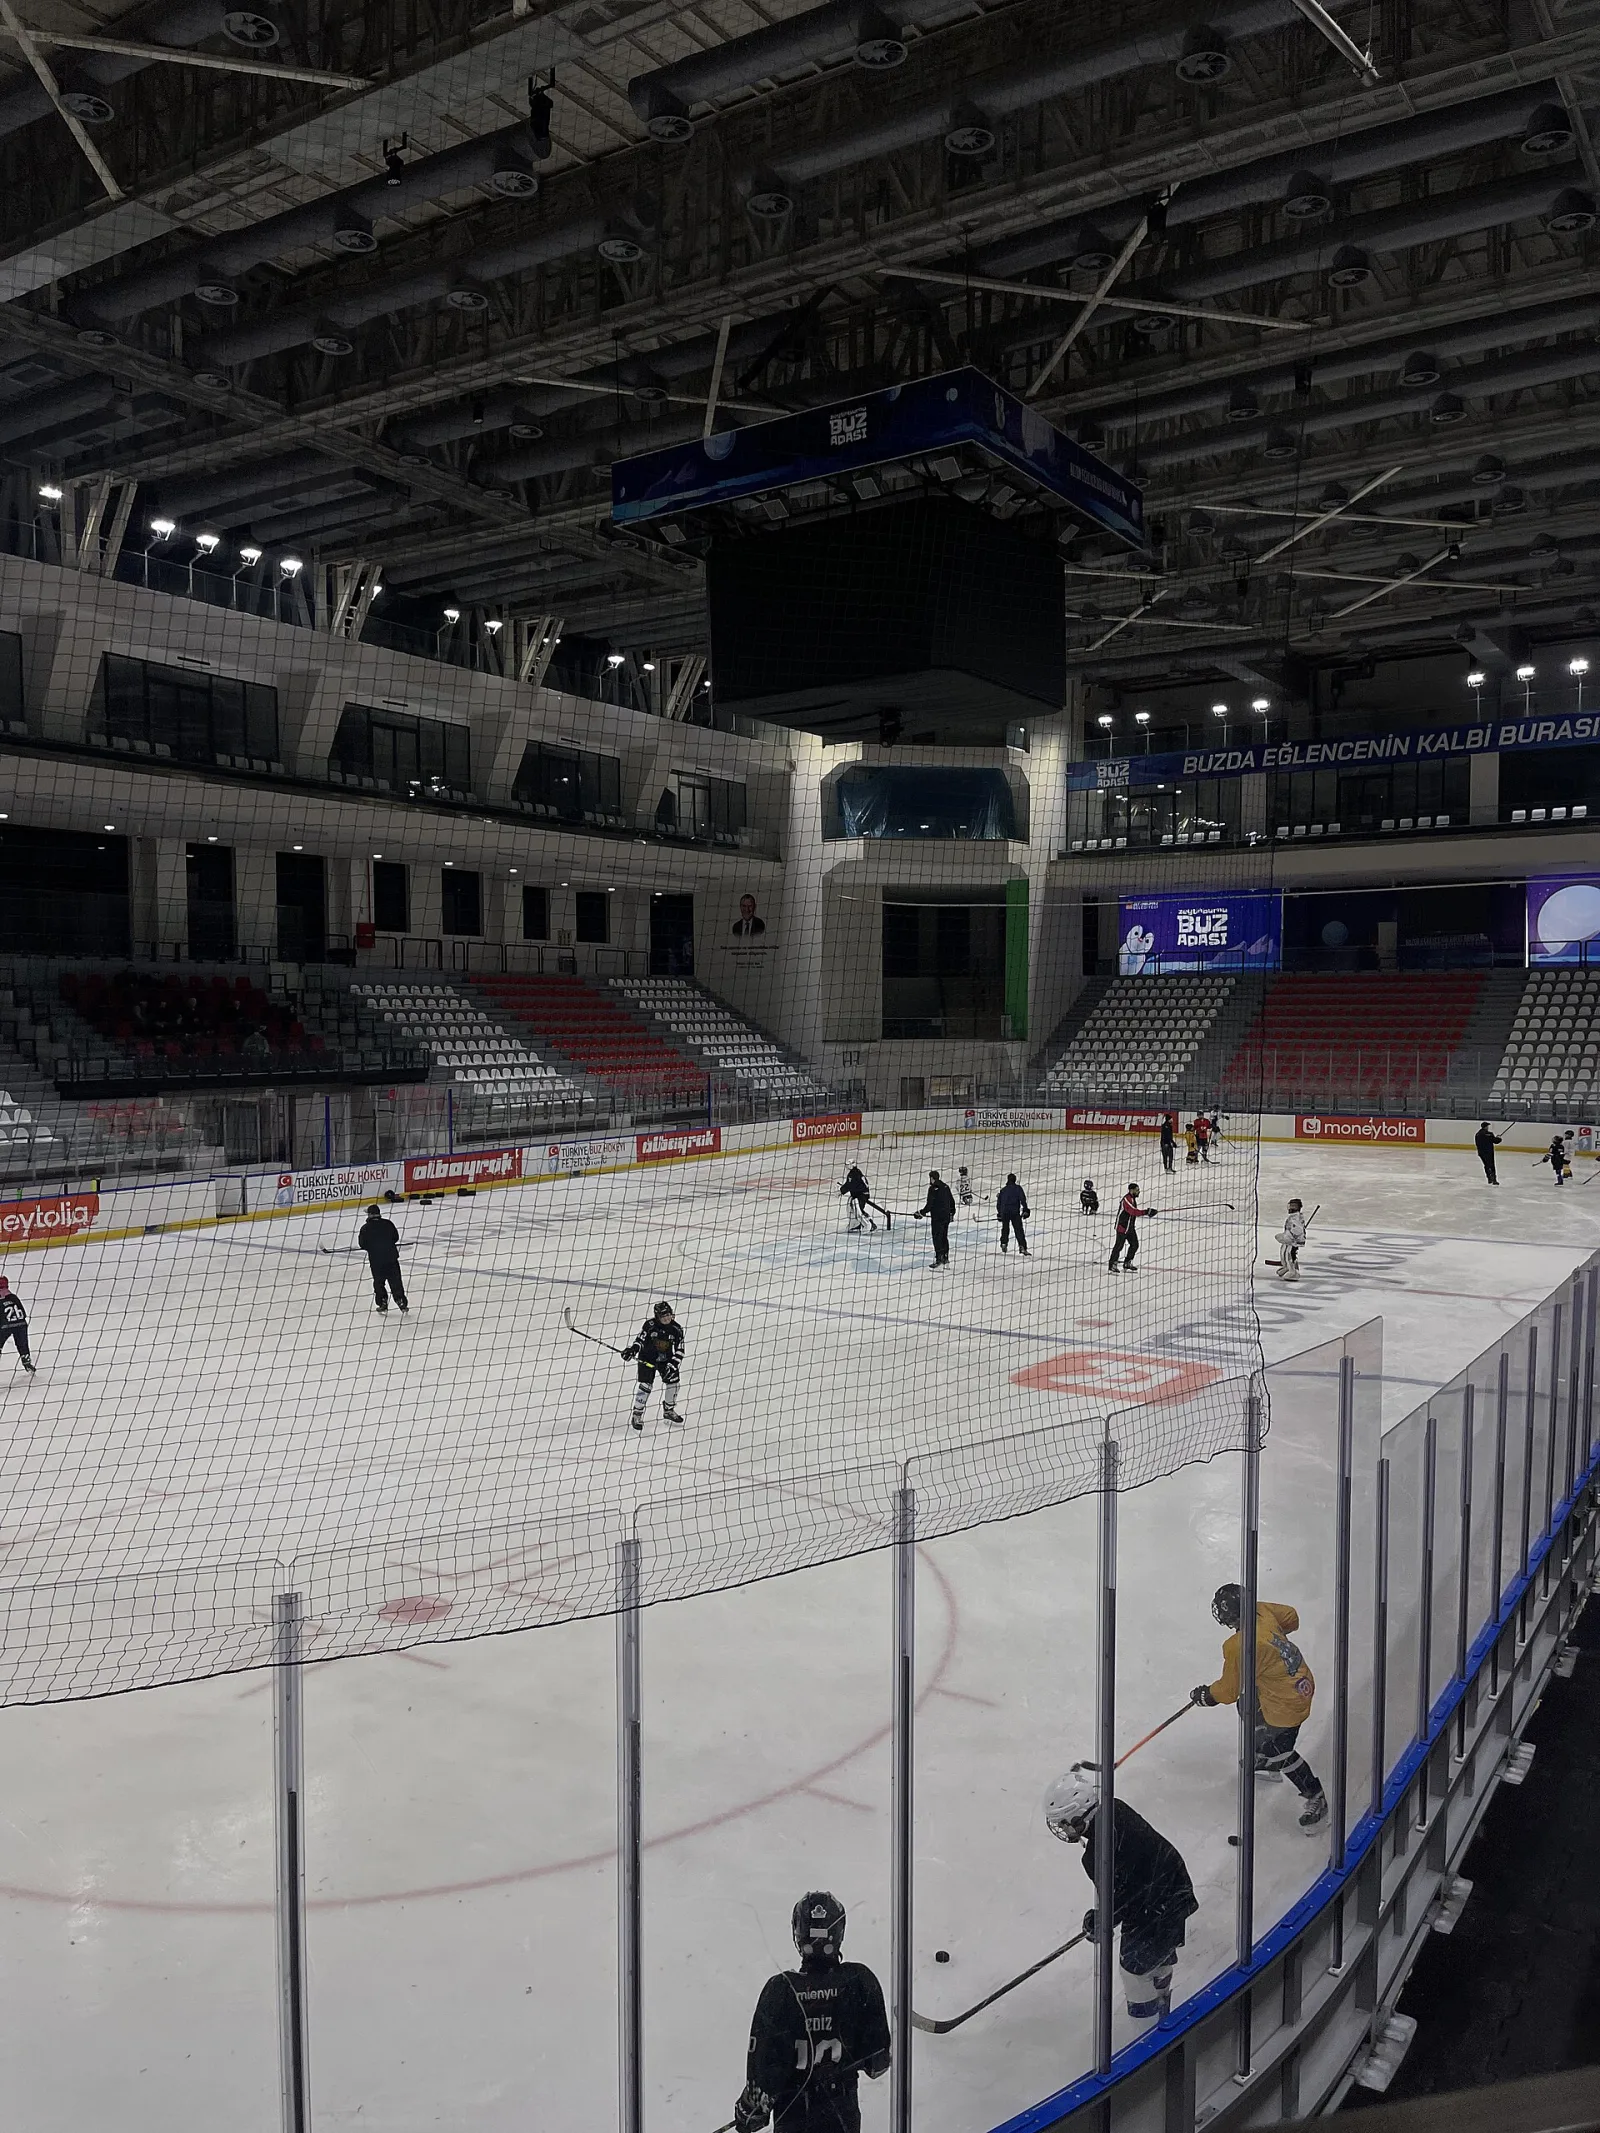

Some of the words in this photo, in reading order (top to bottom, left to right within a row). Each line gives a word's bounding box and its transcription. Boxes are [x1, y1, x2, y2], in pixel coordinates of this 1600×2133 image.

[829, 411, 868, 435] BUZ
[830, 427, 868, 447] ADASI
[1183, 750, 1255, 775] BUZDA
[1262, 732, 1412, 767] EĞLENCENİN
[1416, 722, 1493, 755] KALBİ
[1498, 716, 1600, 746] BURASI
[1096, 763, 1130, 779] BUZ
[1097, 776, 1130, 788] ADASI
[1177, 913, 1228, 934] BUZ
[1177, 932, 1228, 947] ADASI
[807, 1118, 857, 1136] moneytolia
[1324, 1121, 1417, 1140] moneytolia
[641, 1131, 714, 1156] albayrak
[412, 1153, 514, 1183] albayrak
[296, 1172, 335, 1188] TÜRKİYE
[337, 1172, 355, 1185] BUZ
[297, 1184, 363, 1202] FEDERASYONU
[0, 1201, 88, 1238] eytolia
[4, 1304, 24, 1322] 26
